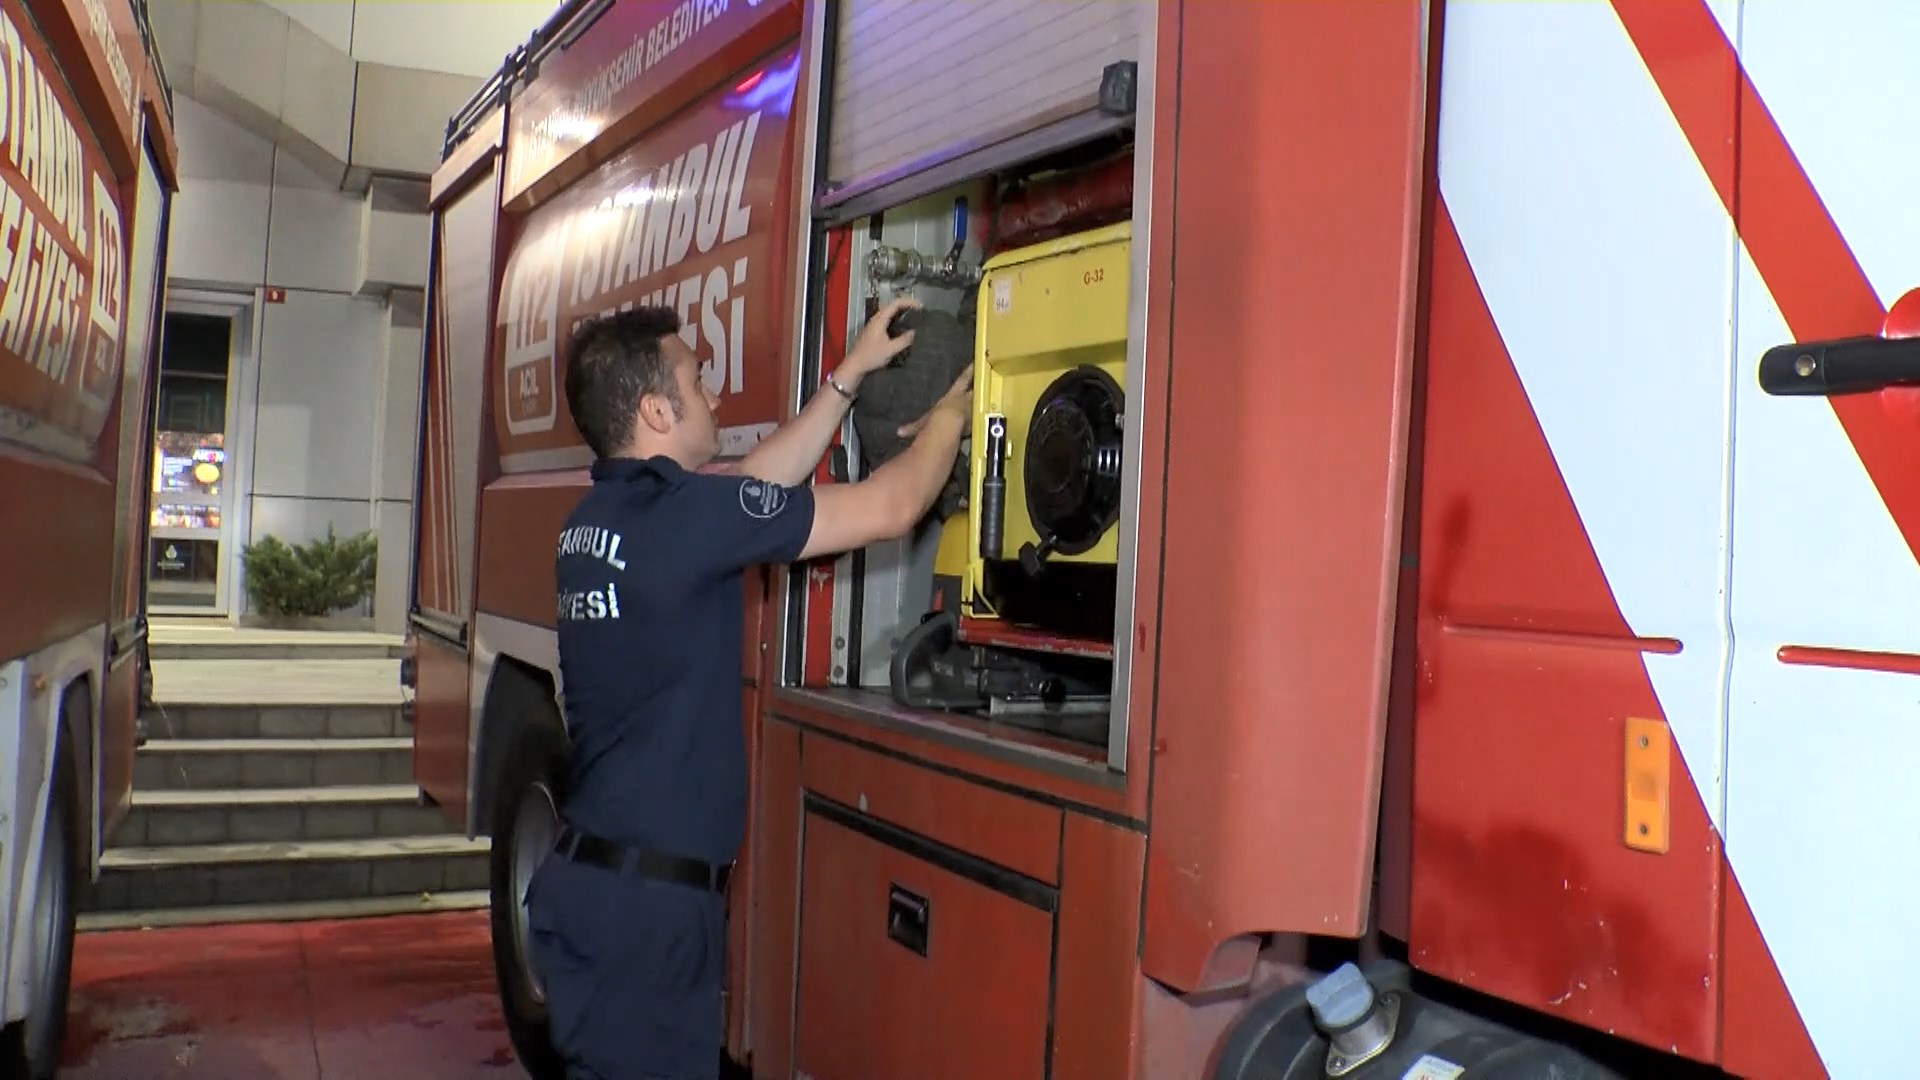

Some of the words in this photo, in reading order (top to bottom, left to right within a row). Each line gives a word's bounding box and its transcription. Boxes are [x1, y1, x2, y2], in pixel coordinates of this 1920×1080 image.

[645, 0, 729, 70] BELEDİYE
[0, 175, 84, 384] FAİYESİ
[1083, 268, 1104, 286] G-32
